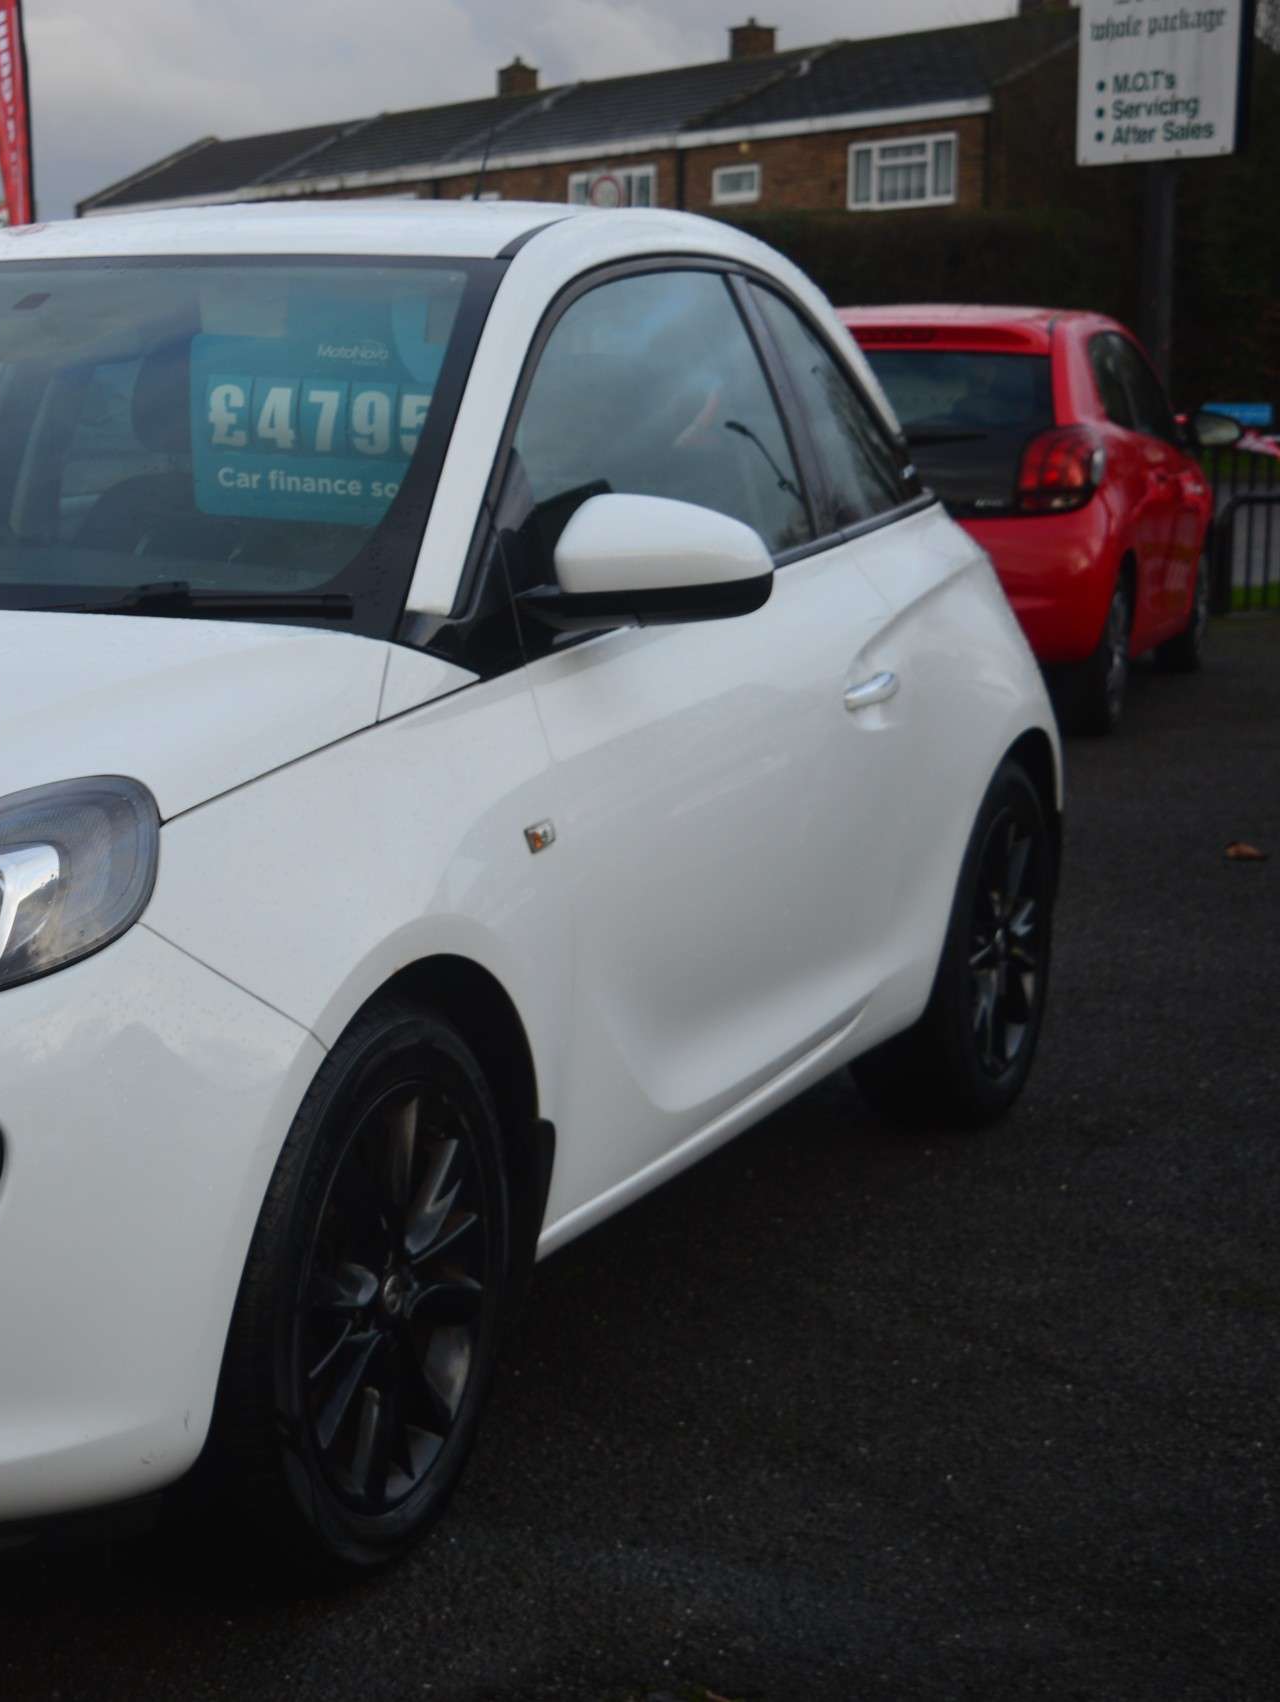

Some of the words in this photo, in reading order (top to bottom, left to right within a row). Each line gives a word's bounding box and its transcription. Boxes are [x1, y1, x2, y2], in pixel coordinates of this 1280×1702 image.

[1147, 7, 1227, 38] package
[1111, 95, 1200, 120] Servicing
[1111, 124, 1155, 146] After
[1162, 119, 1215, 143] Sales
[207, 383, 432, 457] £4795
[218, 466, 261, 489] Car
[269, 470, 363, 496] finance
